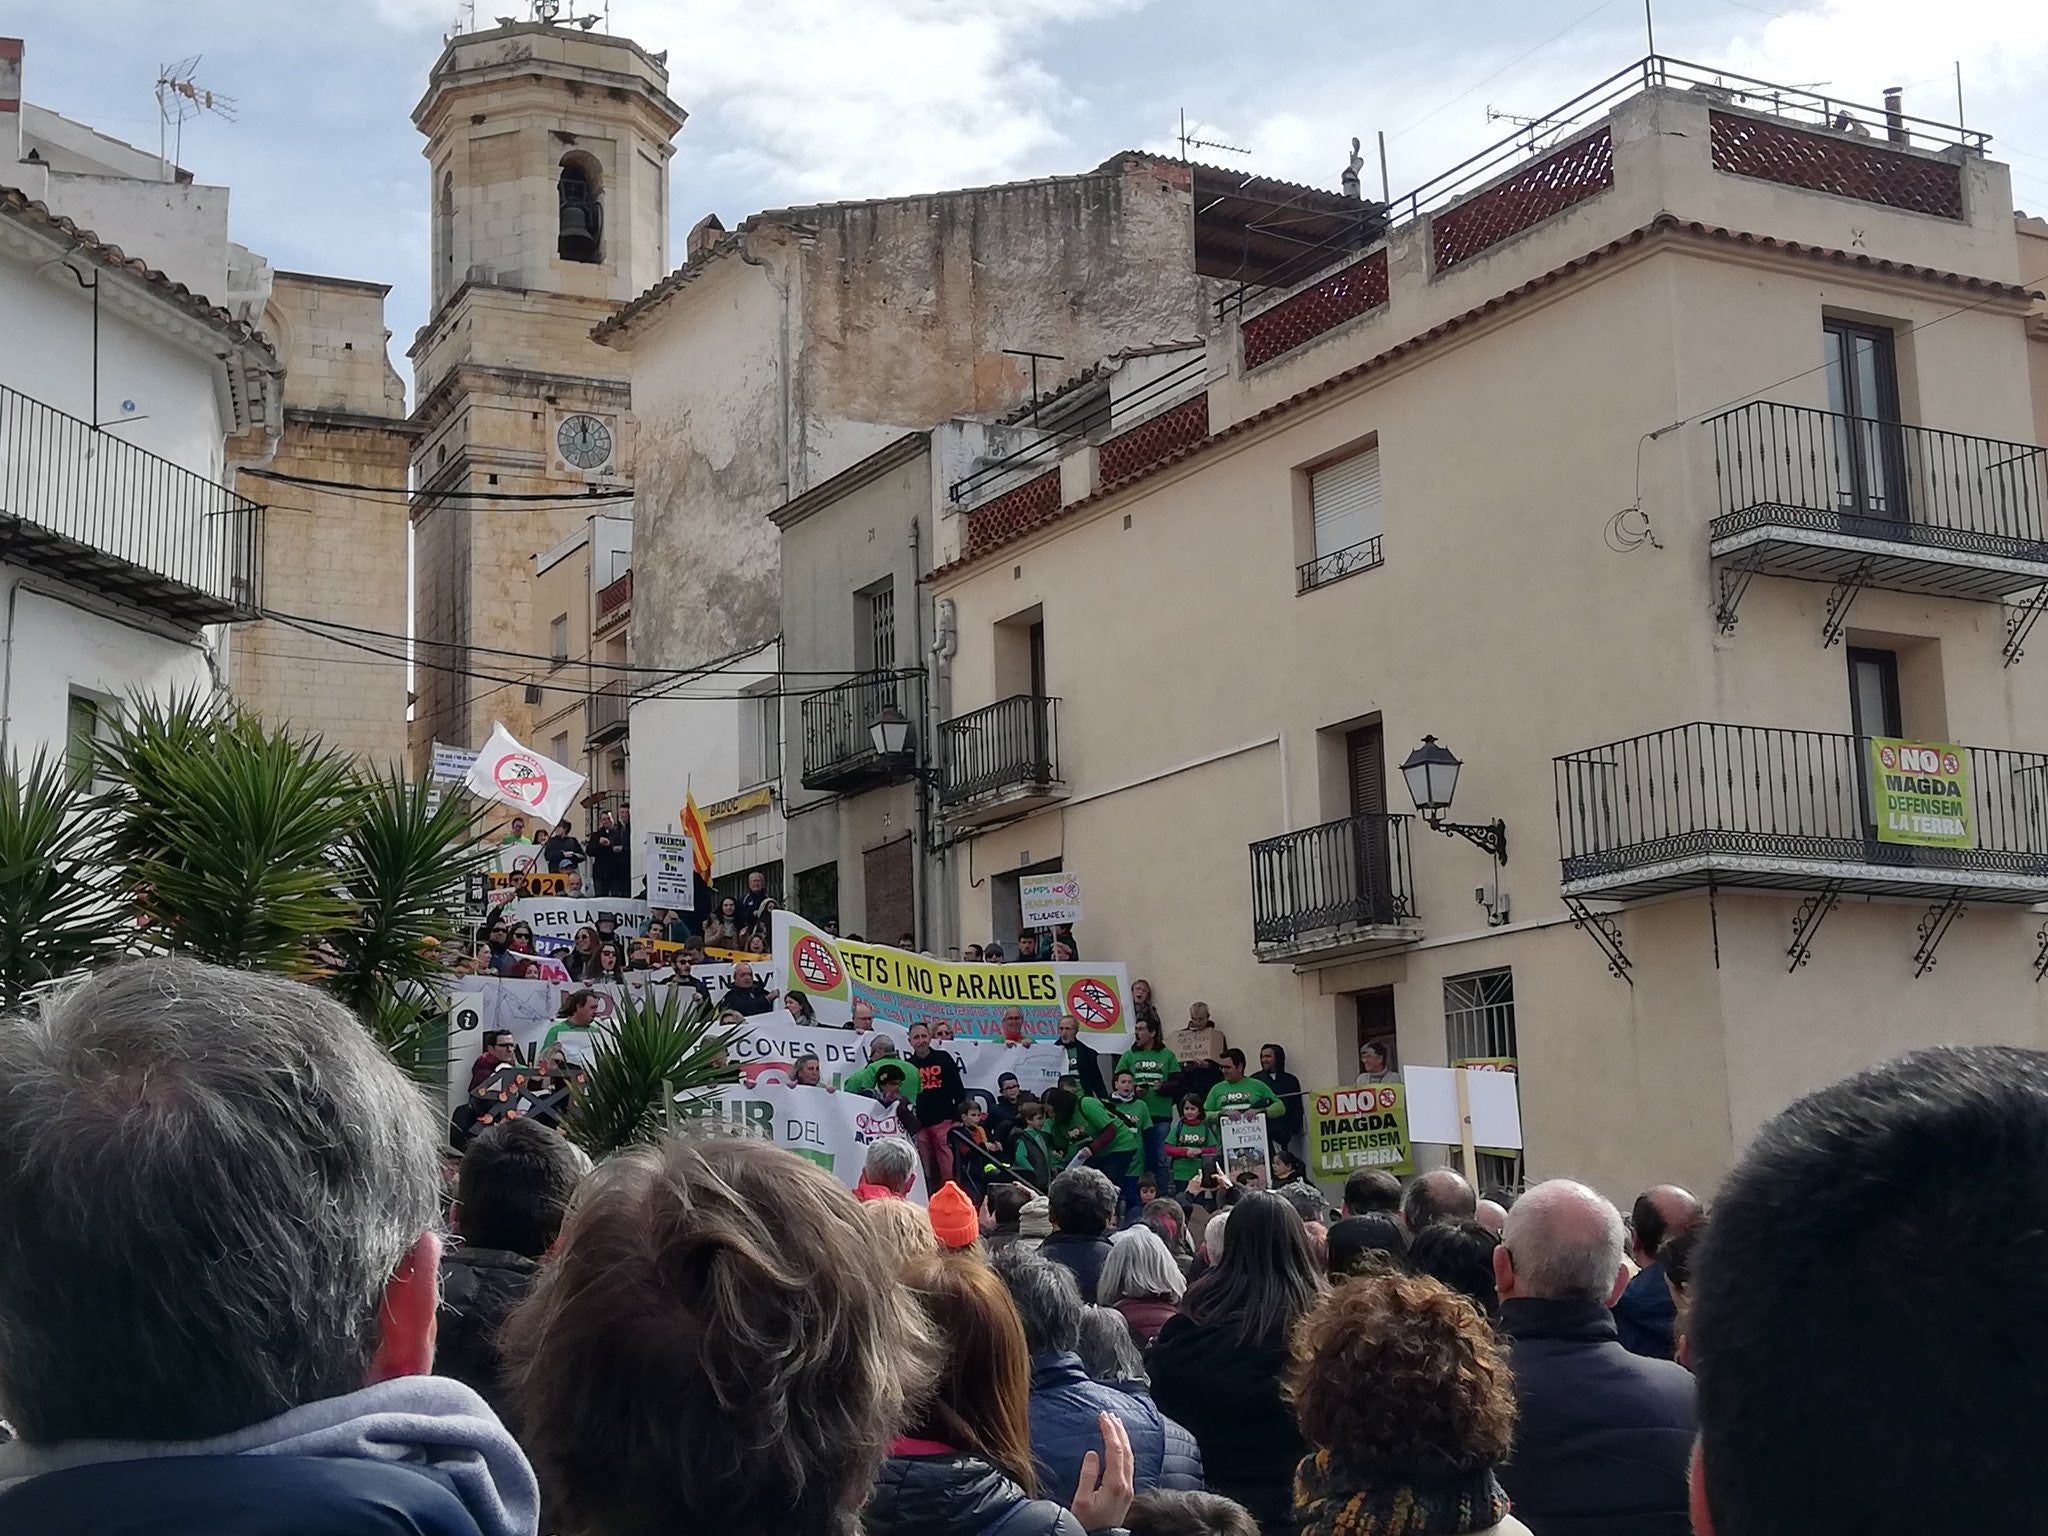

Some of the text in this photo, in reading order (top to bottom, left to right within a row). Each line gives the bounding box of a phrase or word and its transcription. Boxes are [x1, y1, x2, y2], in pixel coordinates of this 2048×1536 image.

[1900, 748, 1939, 774] NO
[1885, 774, 1961, 798] MAGDA
[1888, 795, 1963, 816] DEFENSEM
[1889, 812, 1967, 836] LA TERRA
[1052, 885, 1064, 894] NO
[534, 910, 569, 926] PER
[573, 909, 595, 924] LA
[840, 951, 888, 985] FETS
[895, 961, 902, 987] I
[907, 964, 933, 996] NO
[938, 972, 1057, 1000] PARAULES
[736, 1038, 816, 1056] COVES
[826, 1044, 856, 1063] DE
[919, 1065, 941, 1076] NO
[1336, 1090, 1375, 1114] NO
[787, 1119, 825, 1146] DEL
[1320, 1113, 1397, 1136] MAGDA
[1184, 1134, 1200, 1142] NO
[1321, 1131, 1400, 1153] DEFENSEM
[1321, 1148, 1404, 1170] LA TERRA
